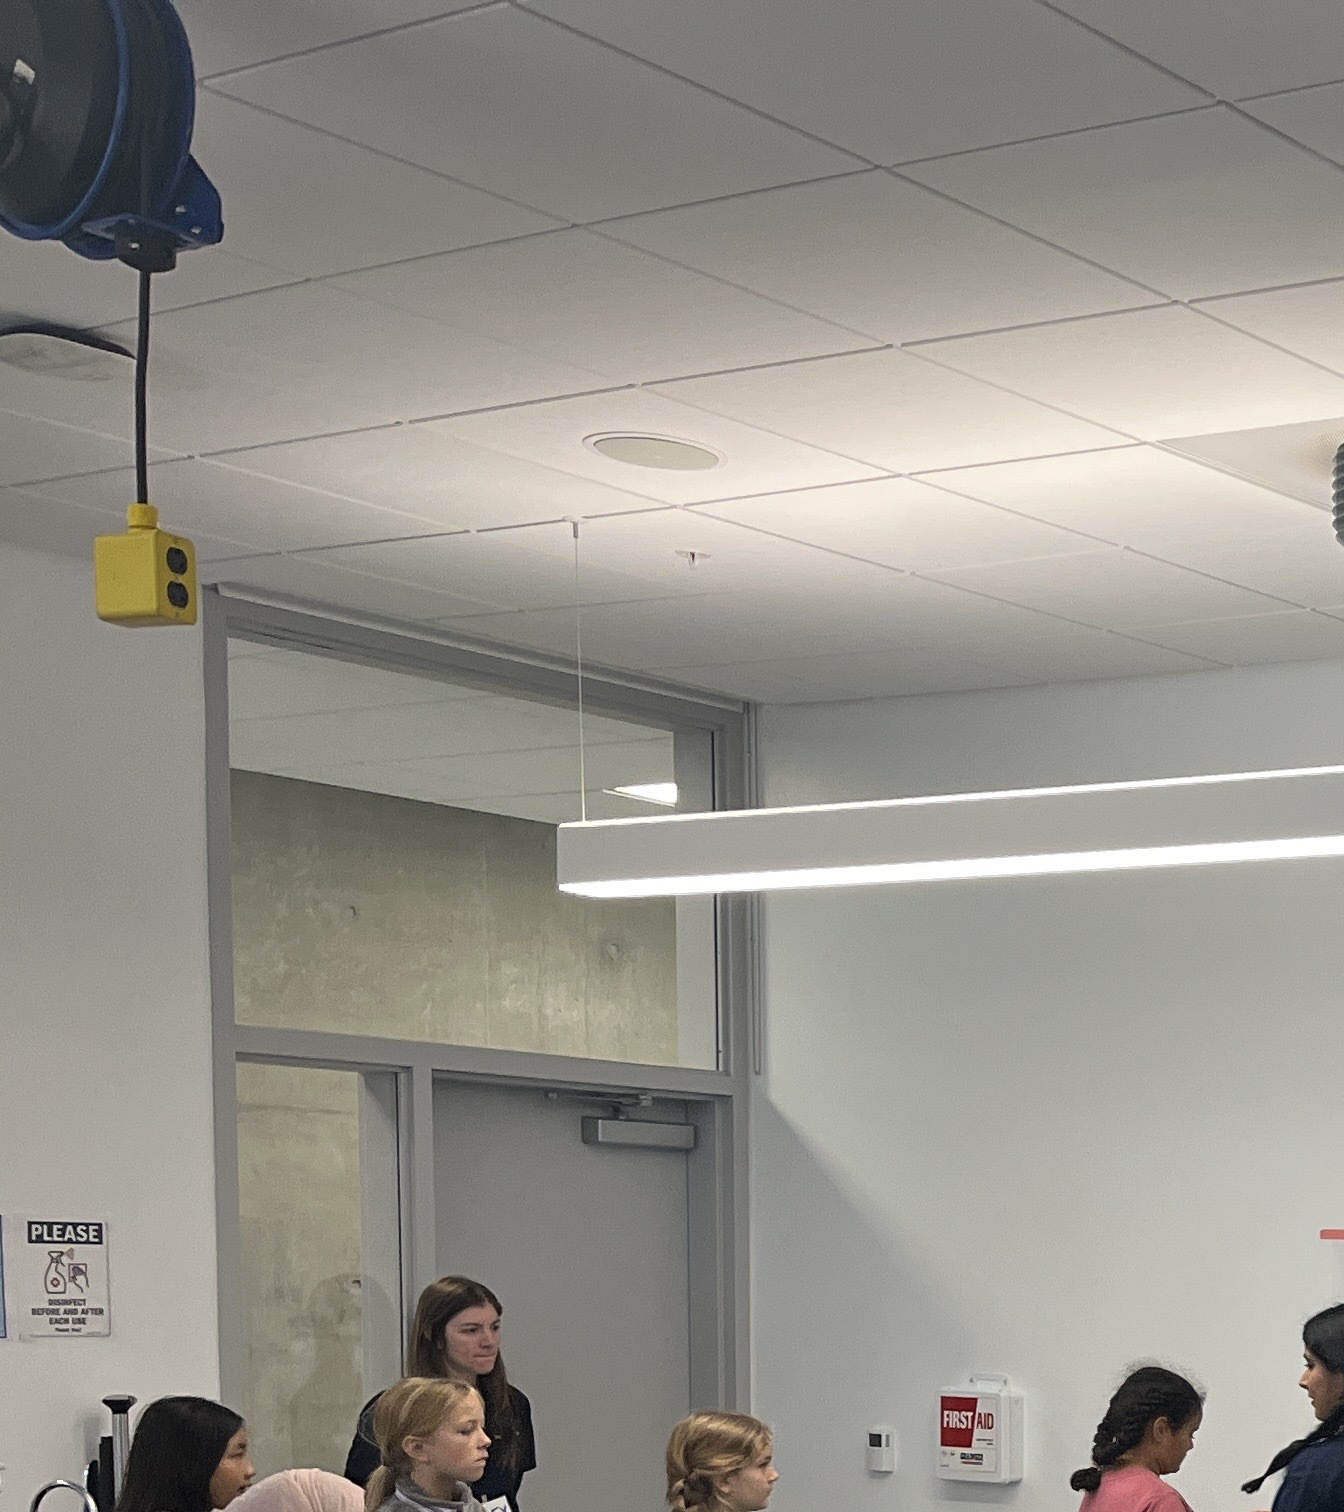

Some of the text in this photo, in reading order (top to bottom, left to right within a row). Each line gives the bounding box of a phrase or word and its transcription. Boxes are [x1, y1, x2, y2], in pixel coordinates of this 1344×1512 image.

[31, 1223, 99, 1242] PLEASE
[943, 1410, 994, 1430] FIRST AID
